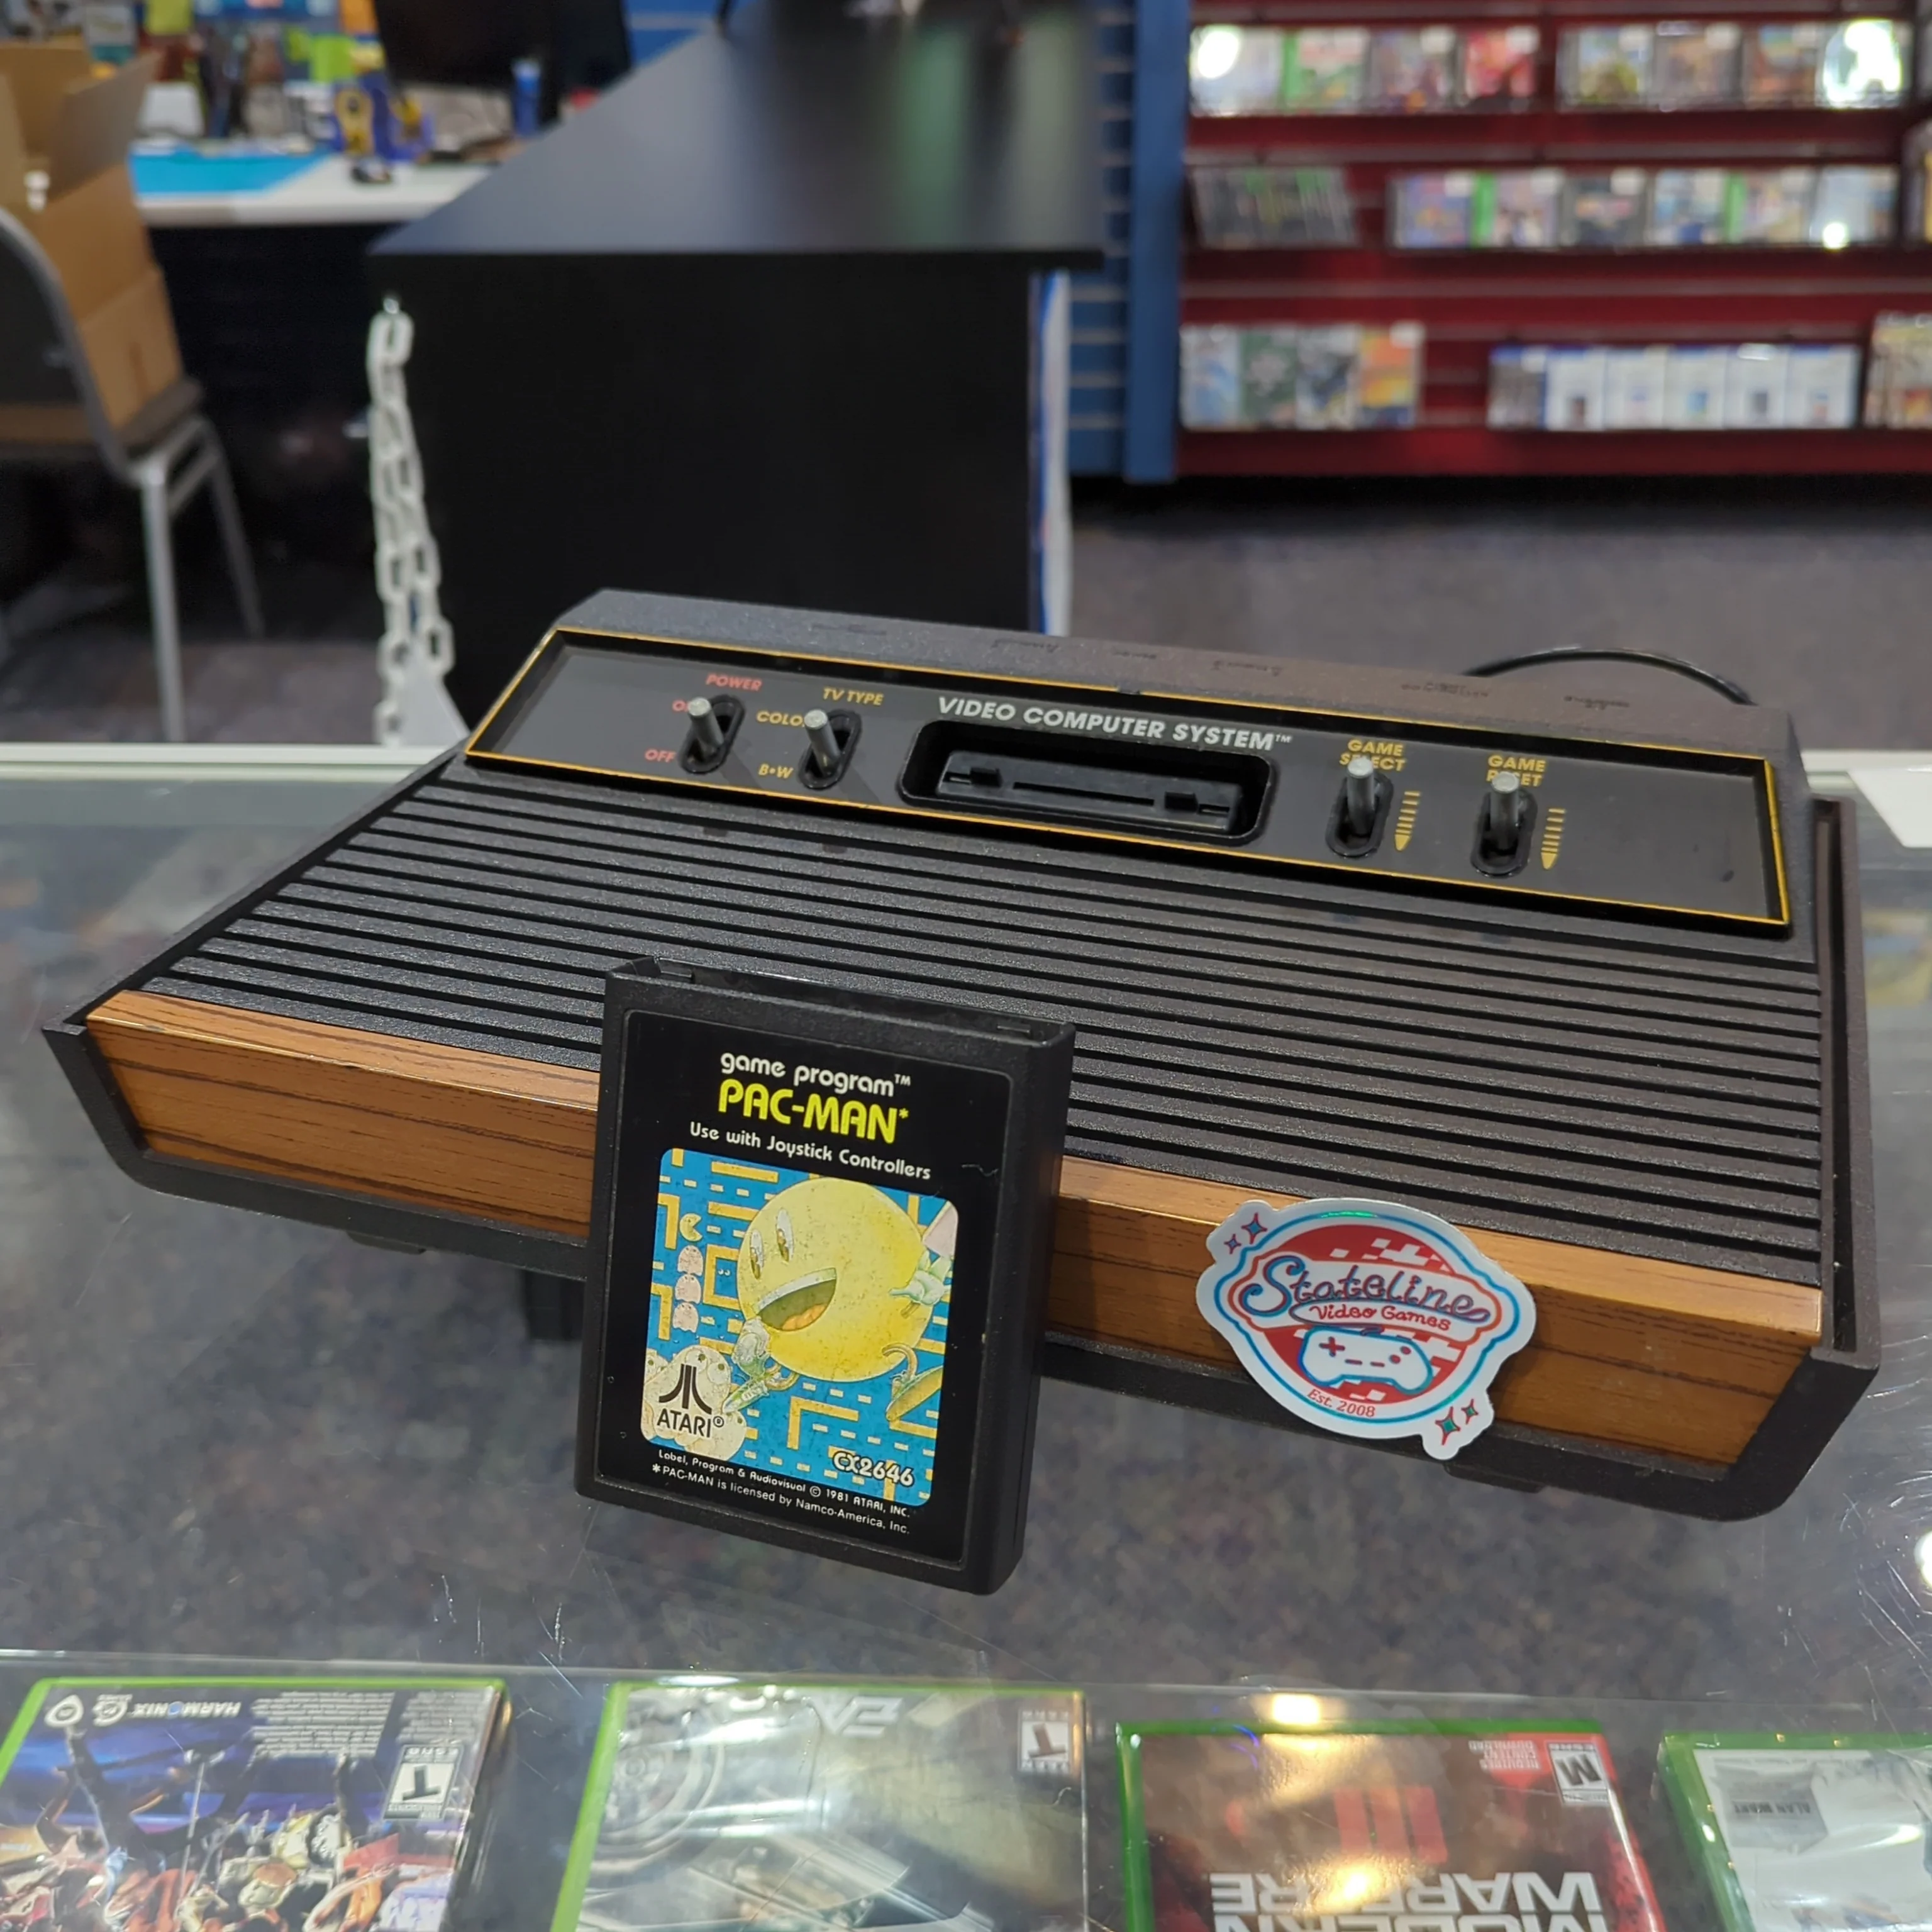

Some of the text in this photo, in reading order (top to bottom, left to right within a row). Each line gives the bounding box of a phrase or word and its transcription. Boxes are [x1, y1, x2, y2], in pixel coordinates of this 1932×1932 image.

[706, 674, 762, 691] POWER
[823, 687, 884, 706] TV TYPE
[757, 711, 805, 728] COLO
[938, 697, 1016, 721] VIDEO
[1023, 706, 1165, 739] COMPUTER
[644, 749, 675, 763] OFF
[1348, 739, 1403, 757] GAME
[1339, 753, 1406, 772] SECT
[1488, 755, 1546, 773] GAME
[1486, 770, 1542, 787] RET
[720, 1053, 786, 1078] game
[690, 1121, 931, 1180] Use with Joystick Controllers
[1240, 1255, 1491, 1323] Stateline
[1309, 1304, 1452, 1331] Video Games
[1307, 1388, 1375, 1418] Est. 2008
[833, 1451, 914, 1487] CX2646
[659, 1450, 689, 1465] Label,
[692, 1458, 735, 1475] Program
[737, 1468, 746, 1477] &
[750, 1472, 806, 1492] Audiovisual
[826, 1489, 849, 1502] 1981
[853, 1496, 886, 1513] ATARI,
[890, 1505, 911, 1518] INC.
[717, 1479, 727, 1490] is
[730, 1482, 776, 1502] licensed
[779, 1494, 792, 1507] by
[889, 1521, 911, 1535] Inc.
[133, 1701, 242, 1719] HARMONIX
[1553, 1753, 1602, 1787] M
[1209, 1872, 1602, 1914] WARFRE
